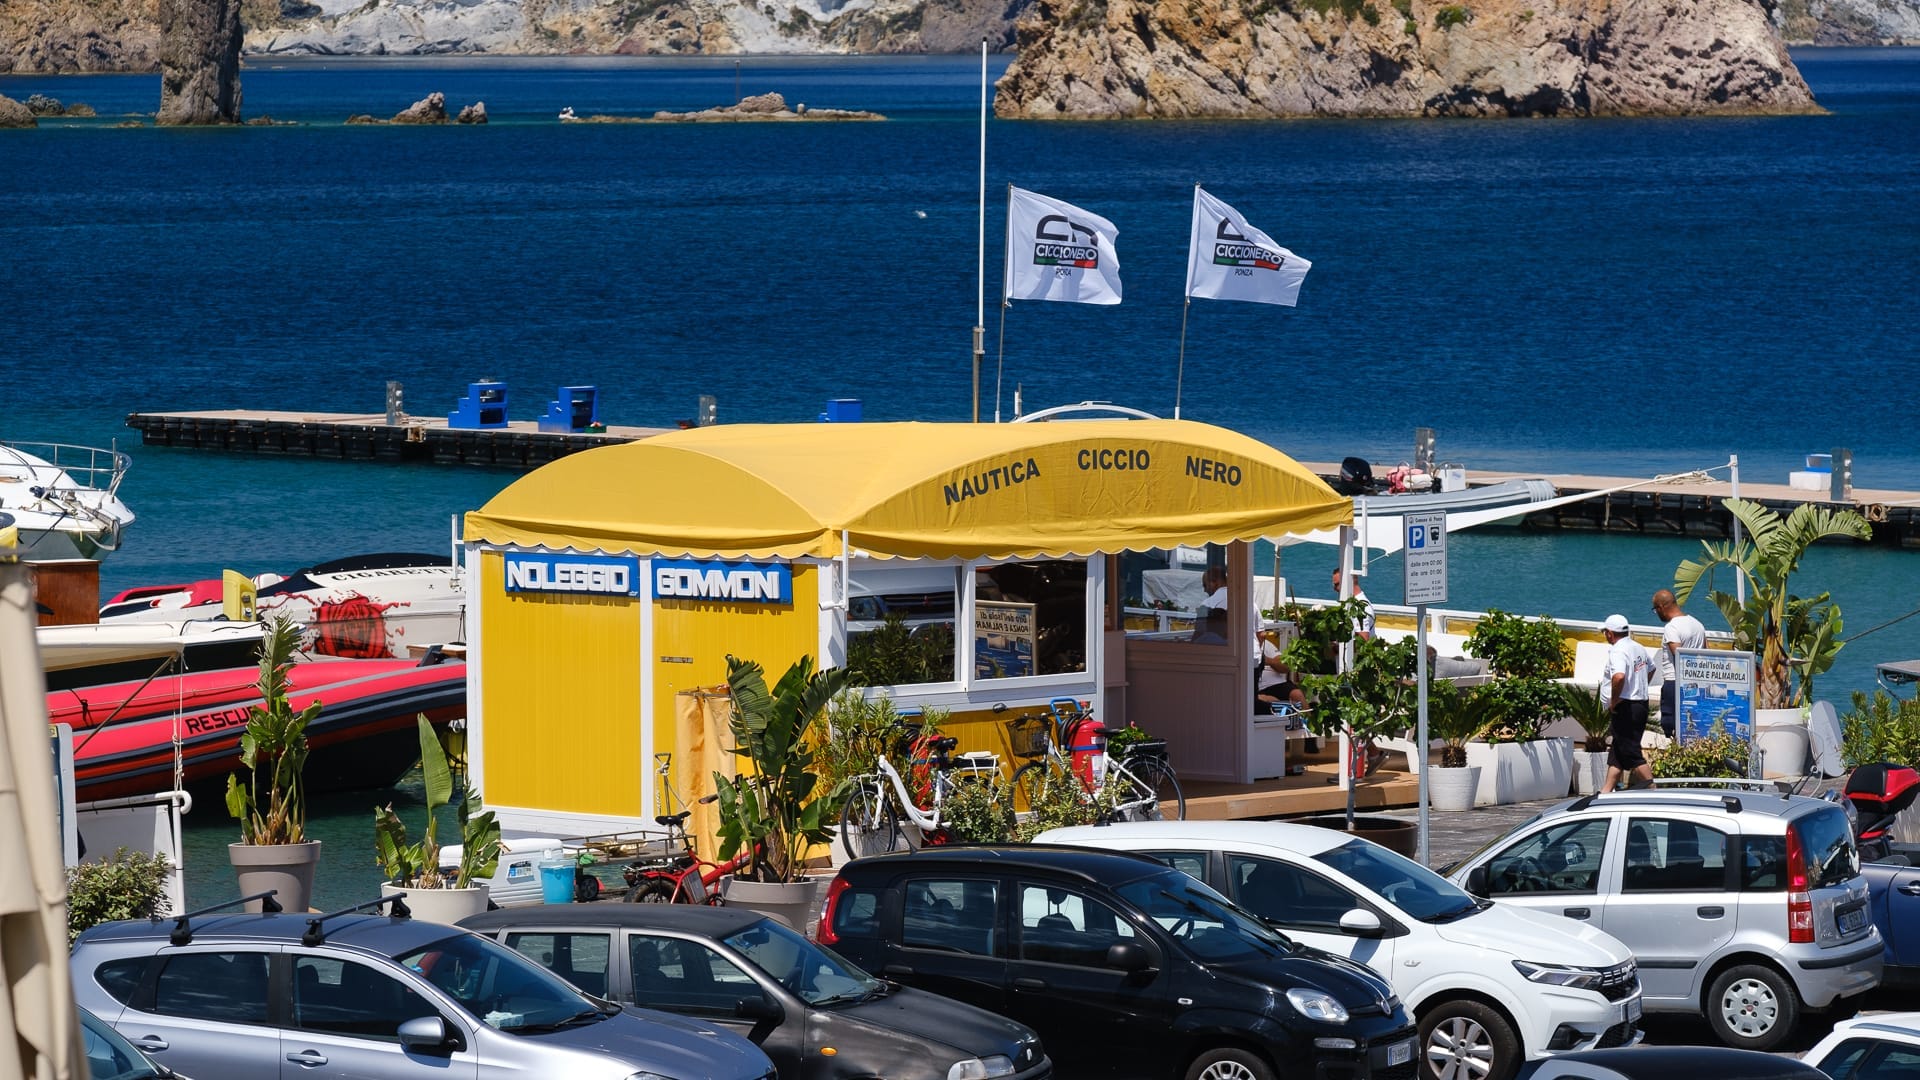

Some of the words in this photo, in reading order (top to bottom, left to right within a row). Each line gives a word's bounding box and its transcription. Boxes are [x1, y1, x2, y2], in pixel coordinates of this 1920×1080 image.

[1036, 245, 1097, 260] CICCIONERO
[1216, 245, 1282, 264] CICCIONERO
[1234, 268, 1253, 277] PONZA
[943, 458, 1041, 506] NAUTICA
[1077, 449, 1150, 470] CICCIO
[1185, 455, 1242, 487] NERO
[1412, 527, 1423, 547] P
[331, 568, 453, 581] CIGARETT
[507, 560, 630, 593] NOLEGGIO
[656, 567, 780, 599] GOMMONI
[1685, 660, 1698, 668] Giro
[1684, 670, 1705, 679] PONZA
[1705, 671, 1710, 679] E
[1711, 671, 1746, 681] PALMAROLA
[185, 706, 253, 735] RESCU
